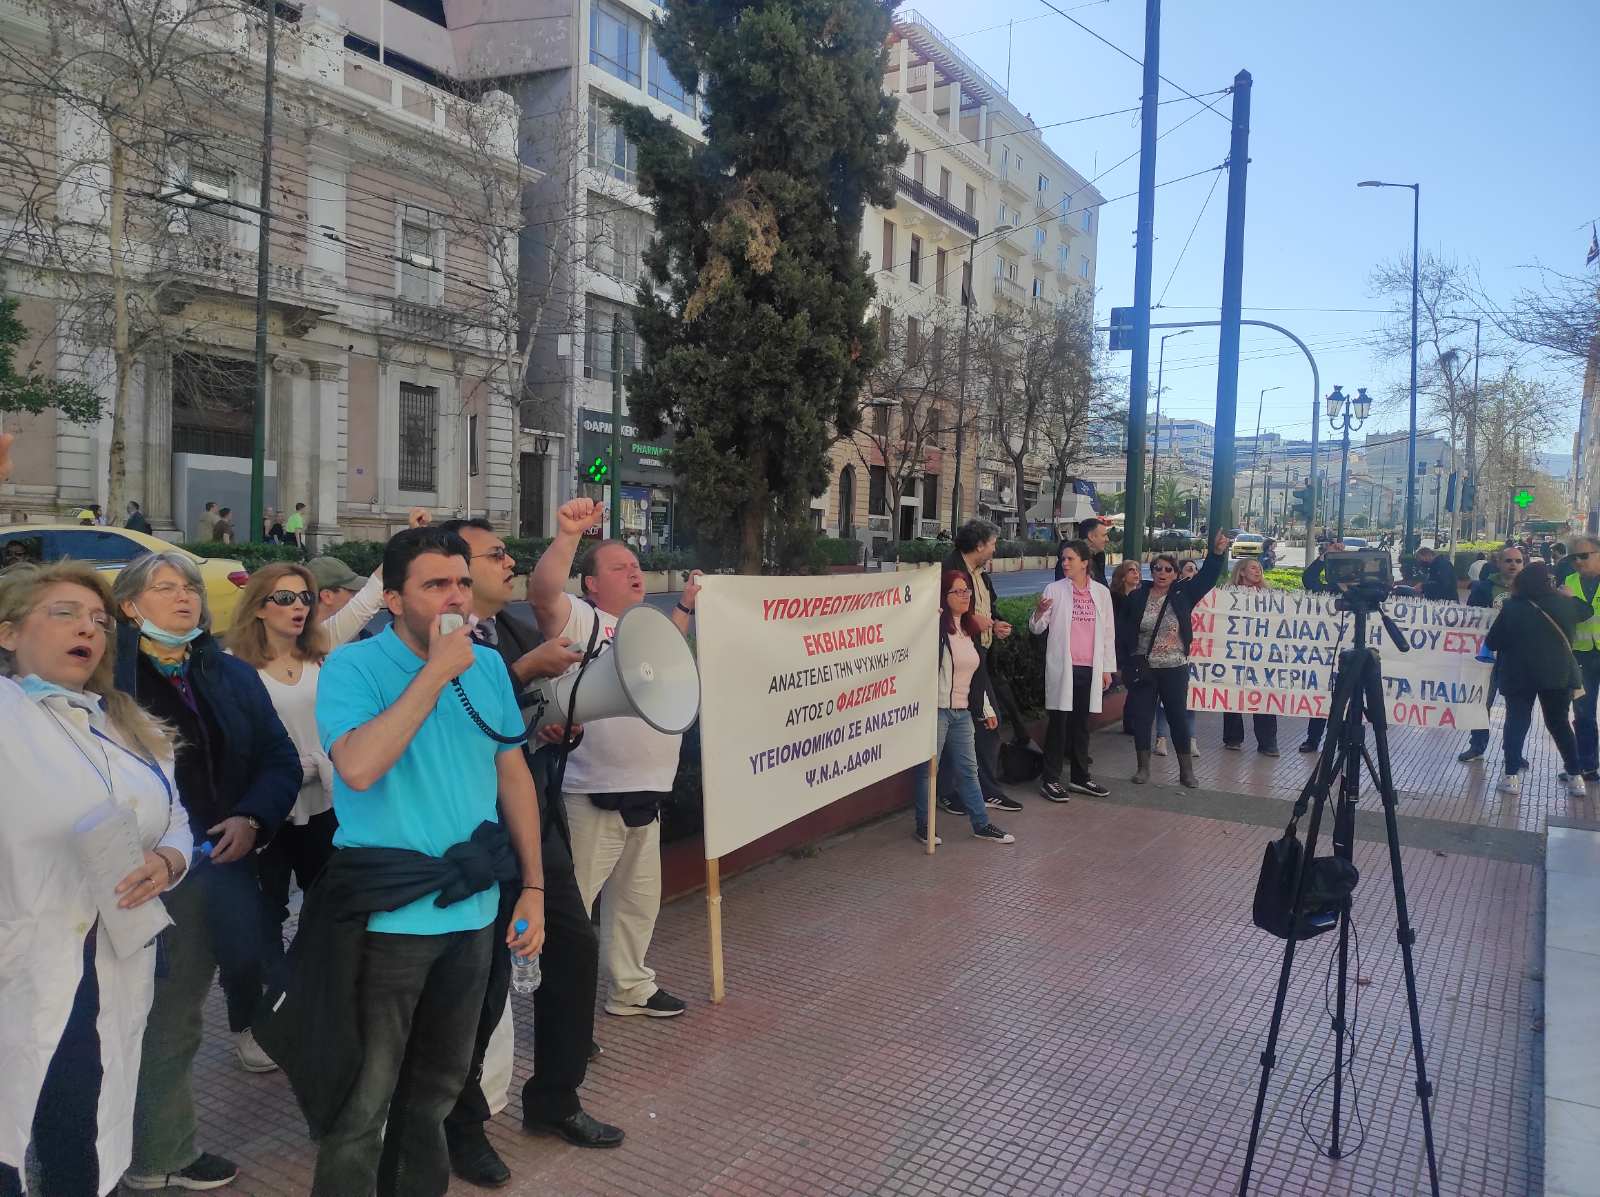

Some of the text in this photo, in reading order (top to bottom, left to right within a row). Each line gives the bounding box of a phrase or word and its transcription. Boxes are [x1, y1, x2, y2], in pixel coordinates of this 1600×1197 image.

[762, 585, 912, 621] ΥΠΟΧΡΕΩΤΙΚΟΤΗΤΑ &
[1230, 591, 1285, 614] ΣΤΗΝ
[803, 623, 885, 656] ΕΚΒΙΑΣΜΟΣ
[1190, 613, 1215, 633] ΧΙ
[1226, 615, 1270, 638] ΣΤΗ
[1276, 619, 1382, 645] ΔΙΑΛΥΗ
[1190, 637, 1214, 657] ΧΙ
[1225, 640, 1263, 662] ΣΤΟ
[768, 647, 910, 694] ΑΝΑΣΤΕΛΕΙ ΤΗΝ ΨΥΧΙΚΗ ΥΓΕΙΑ
[1188, 662, 1226, 684] ΑΤΩ
[1231, 664, 1259, 686] ΤΑ
[1263, 667, 1319, 690] ΧΕΡΙΑ
[1382, 676, 1412, 700] ΤΑ
[785, 675, 897, 727] ΑΥΤΟΣ Ο ΦΑΣΙΣΜΟΣ
[1393, 702, 1456, 730] ΟΛΓΑ
[749, 702, 920, 775] ΥΓΕΙΟΝΟΜΙΚΟΙ ΣΕ ΑΝΑΣΤΟΛΗ
